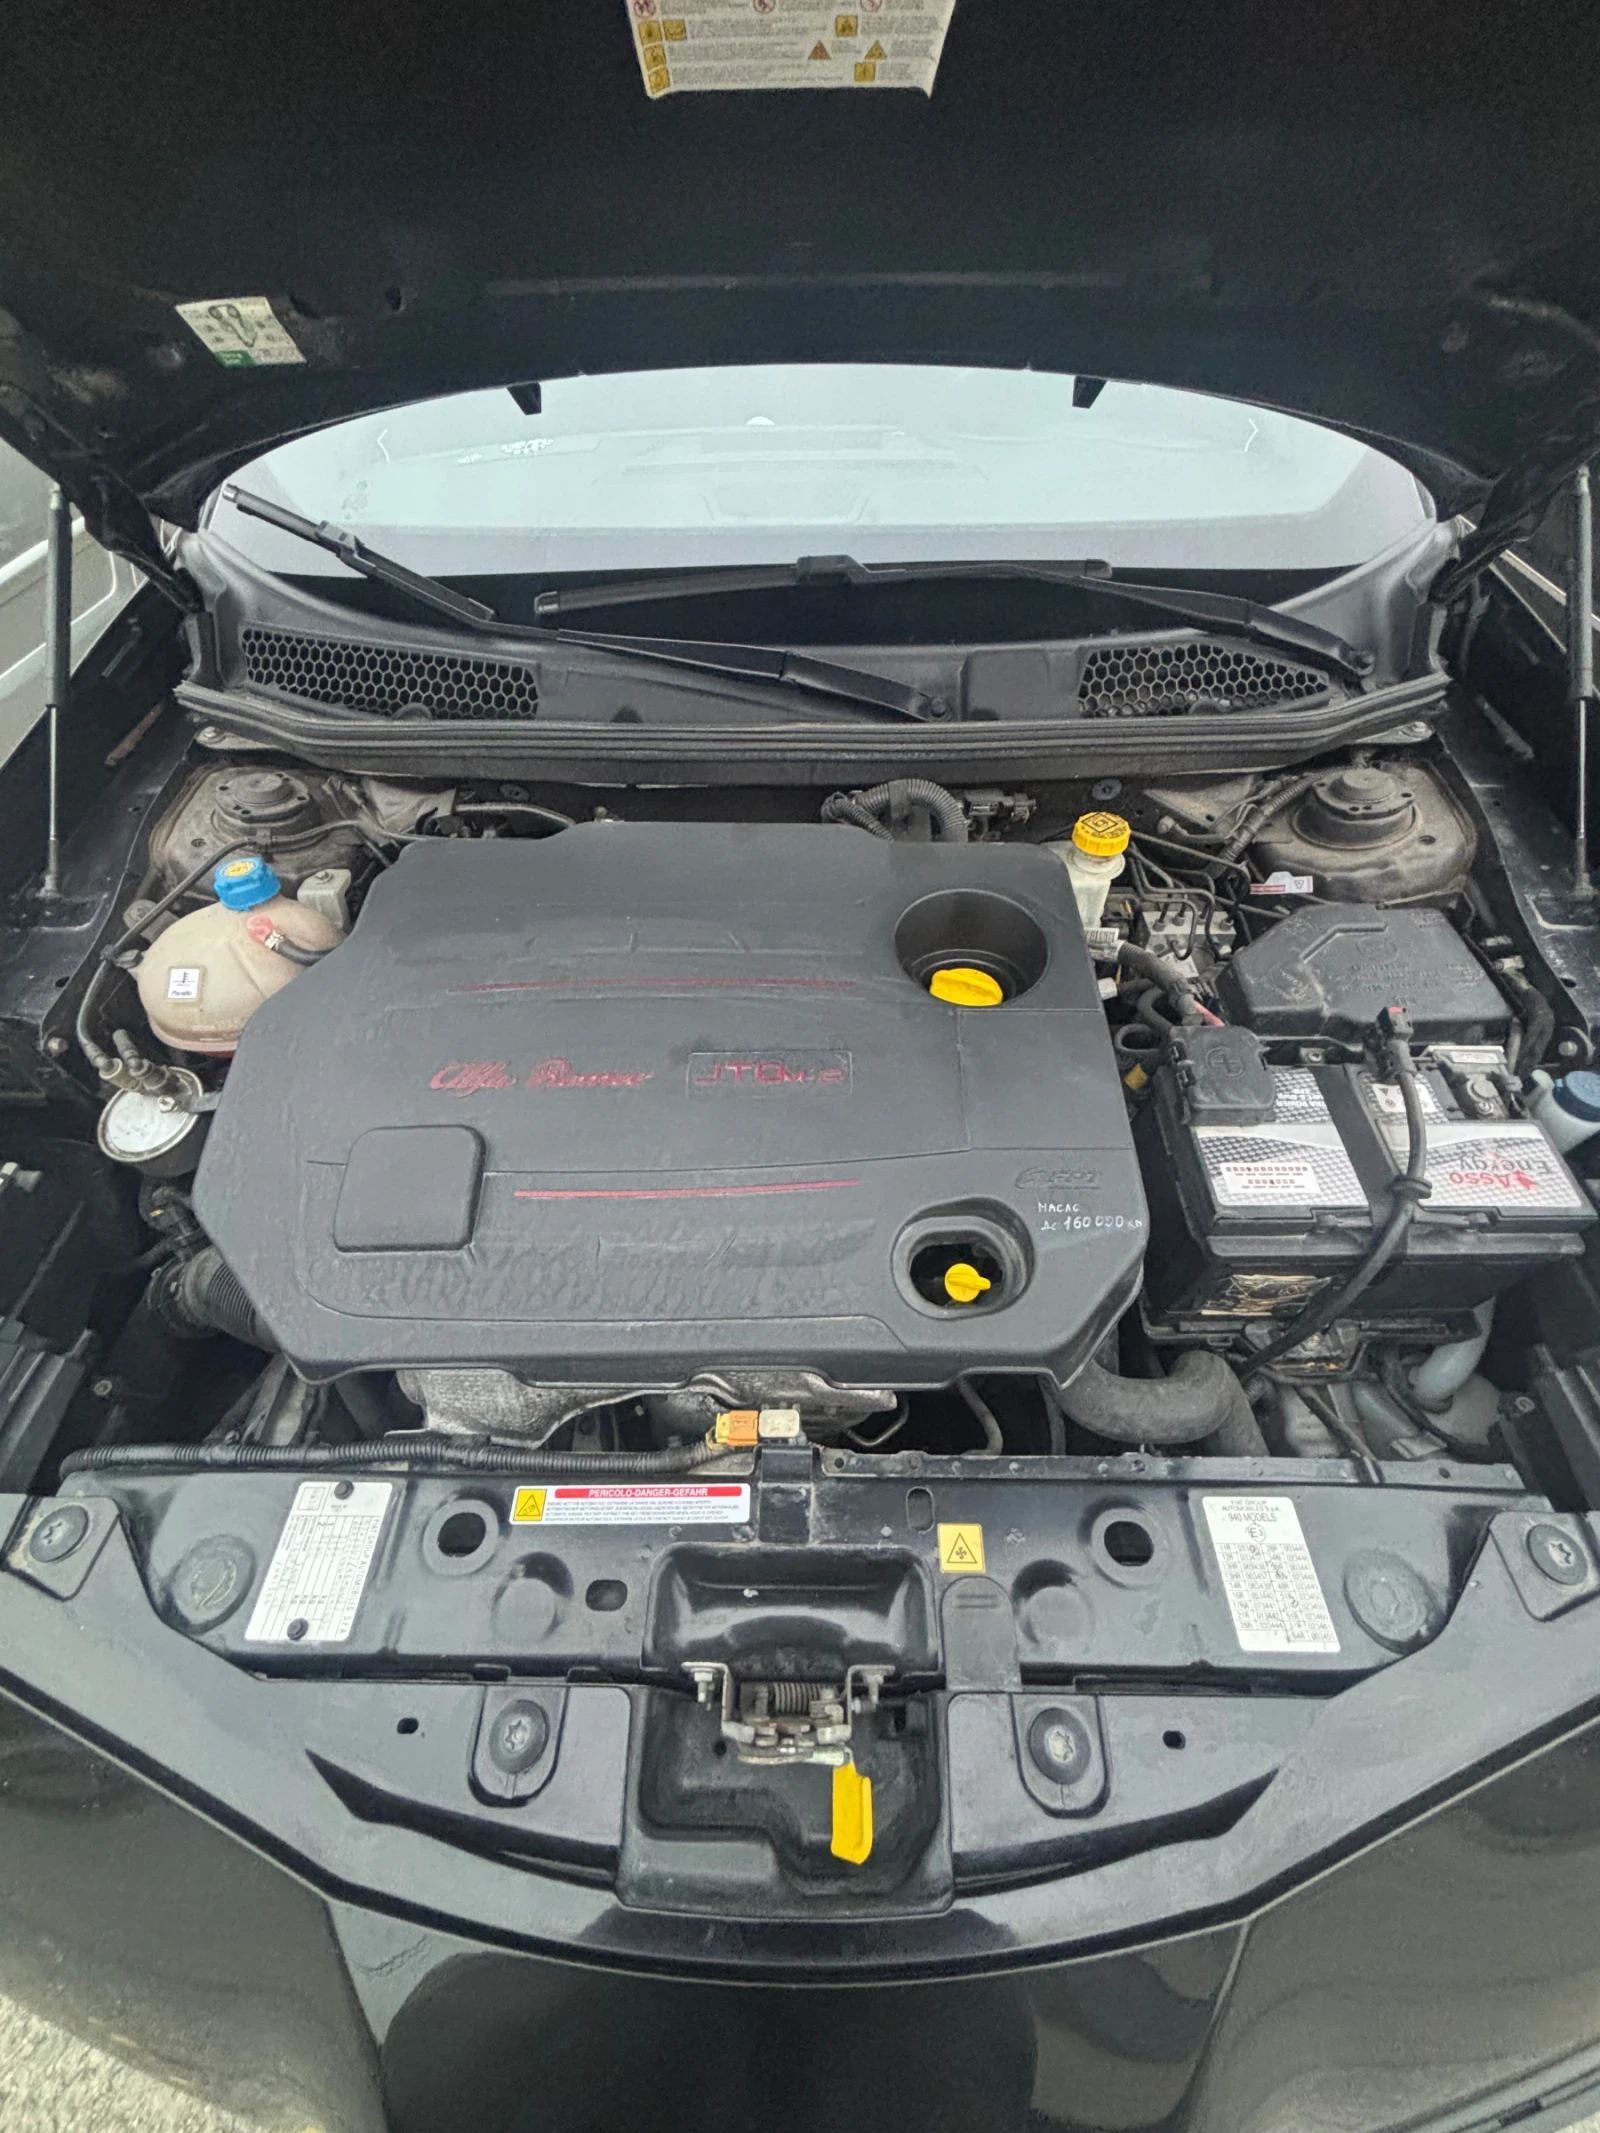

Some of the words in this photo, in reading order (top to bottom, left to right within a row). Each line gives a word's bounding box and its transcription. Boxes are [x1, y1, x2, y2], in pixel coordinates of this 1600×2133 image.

[588, 1488, 708, 1497] PERICOLO-DANGER-GEFAHR
[1227, 1512, 1242, 1522] 940
[1243, 1512, 1277, 1522] MODELS
